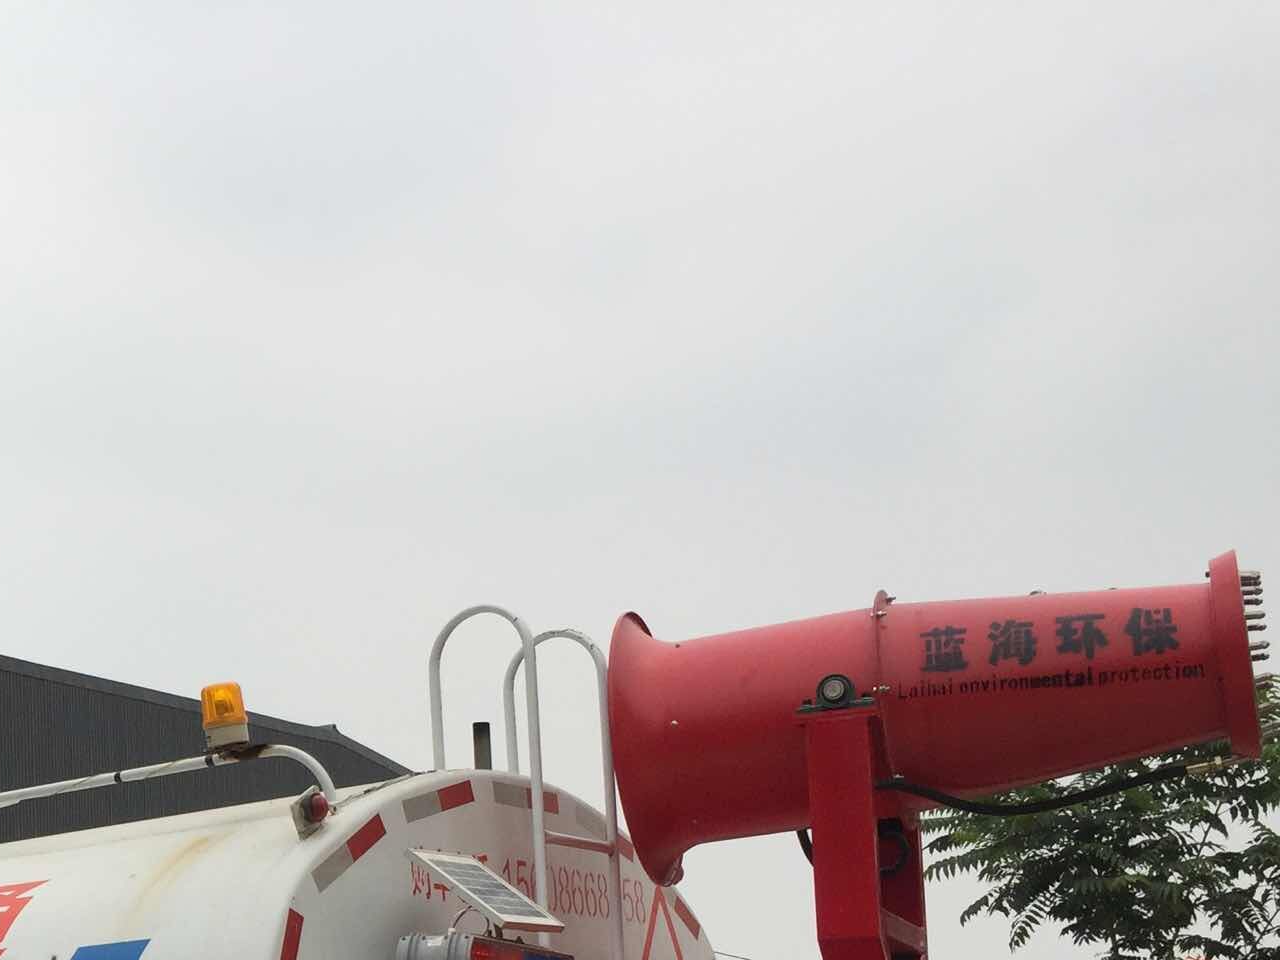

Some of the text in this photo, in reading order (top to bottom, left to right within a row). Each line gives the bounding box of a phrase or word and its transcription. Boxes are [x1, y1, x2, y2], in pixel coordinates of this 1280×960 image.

[920, 607, 1181, 672] 蓝海环保
[1098, 663, 1207, 687] protection
